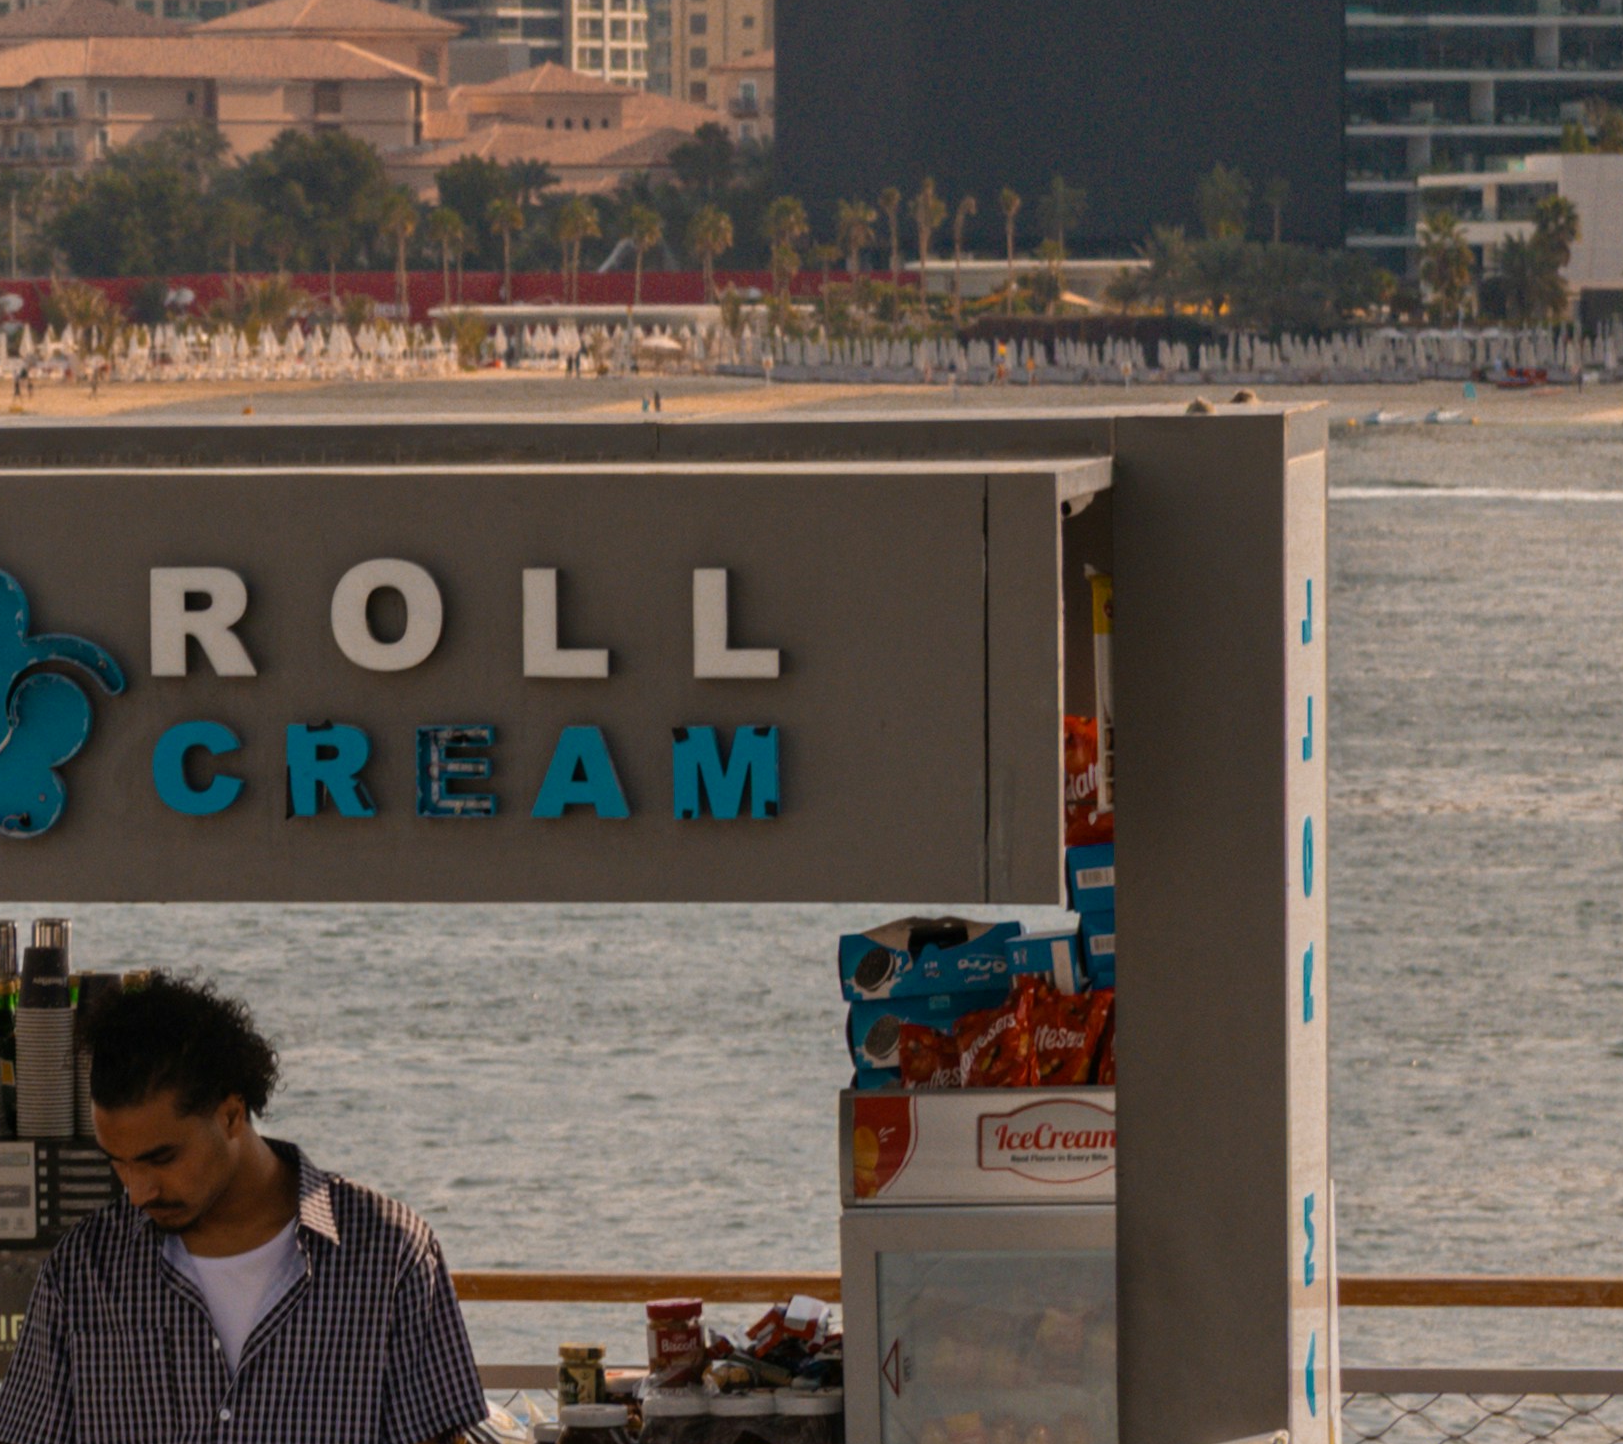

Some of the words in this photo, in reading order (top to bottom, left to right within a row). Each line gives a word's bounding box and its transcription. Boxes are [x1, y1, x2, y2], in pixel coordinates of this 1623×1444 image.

[149, 559, 782, 679] ROLL
[149, 717, 782, 819] CREAM
[1301, 578, 1315, 1024] ROLL
[995, 1122, 1116, 1150] IceCream
